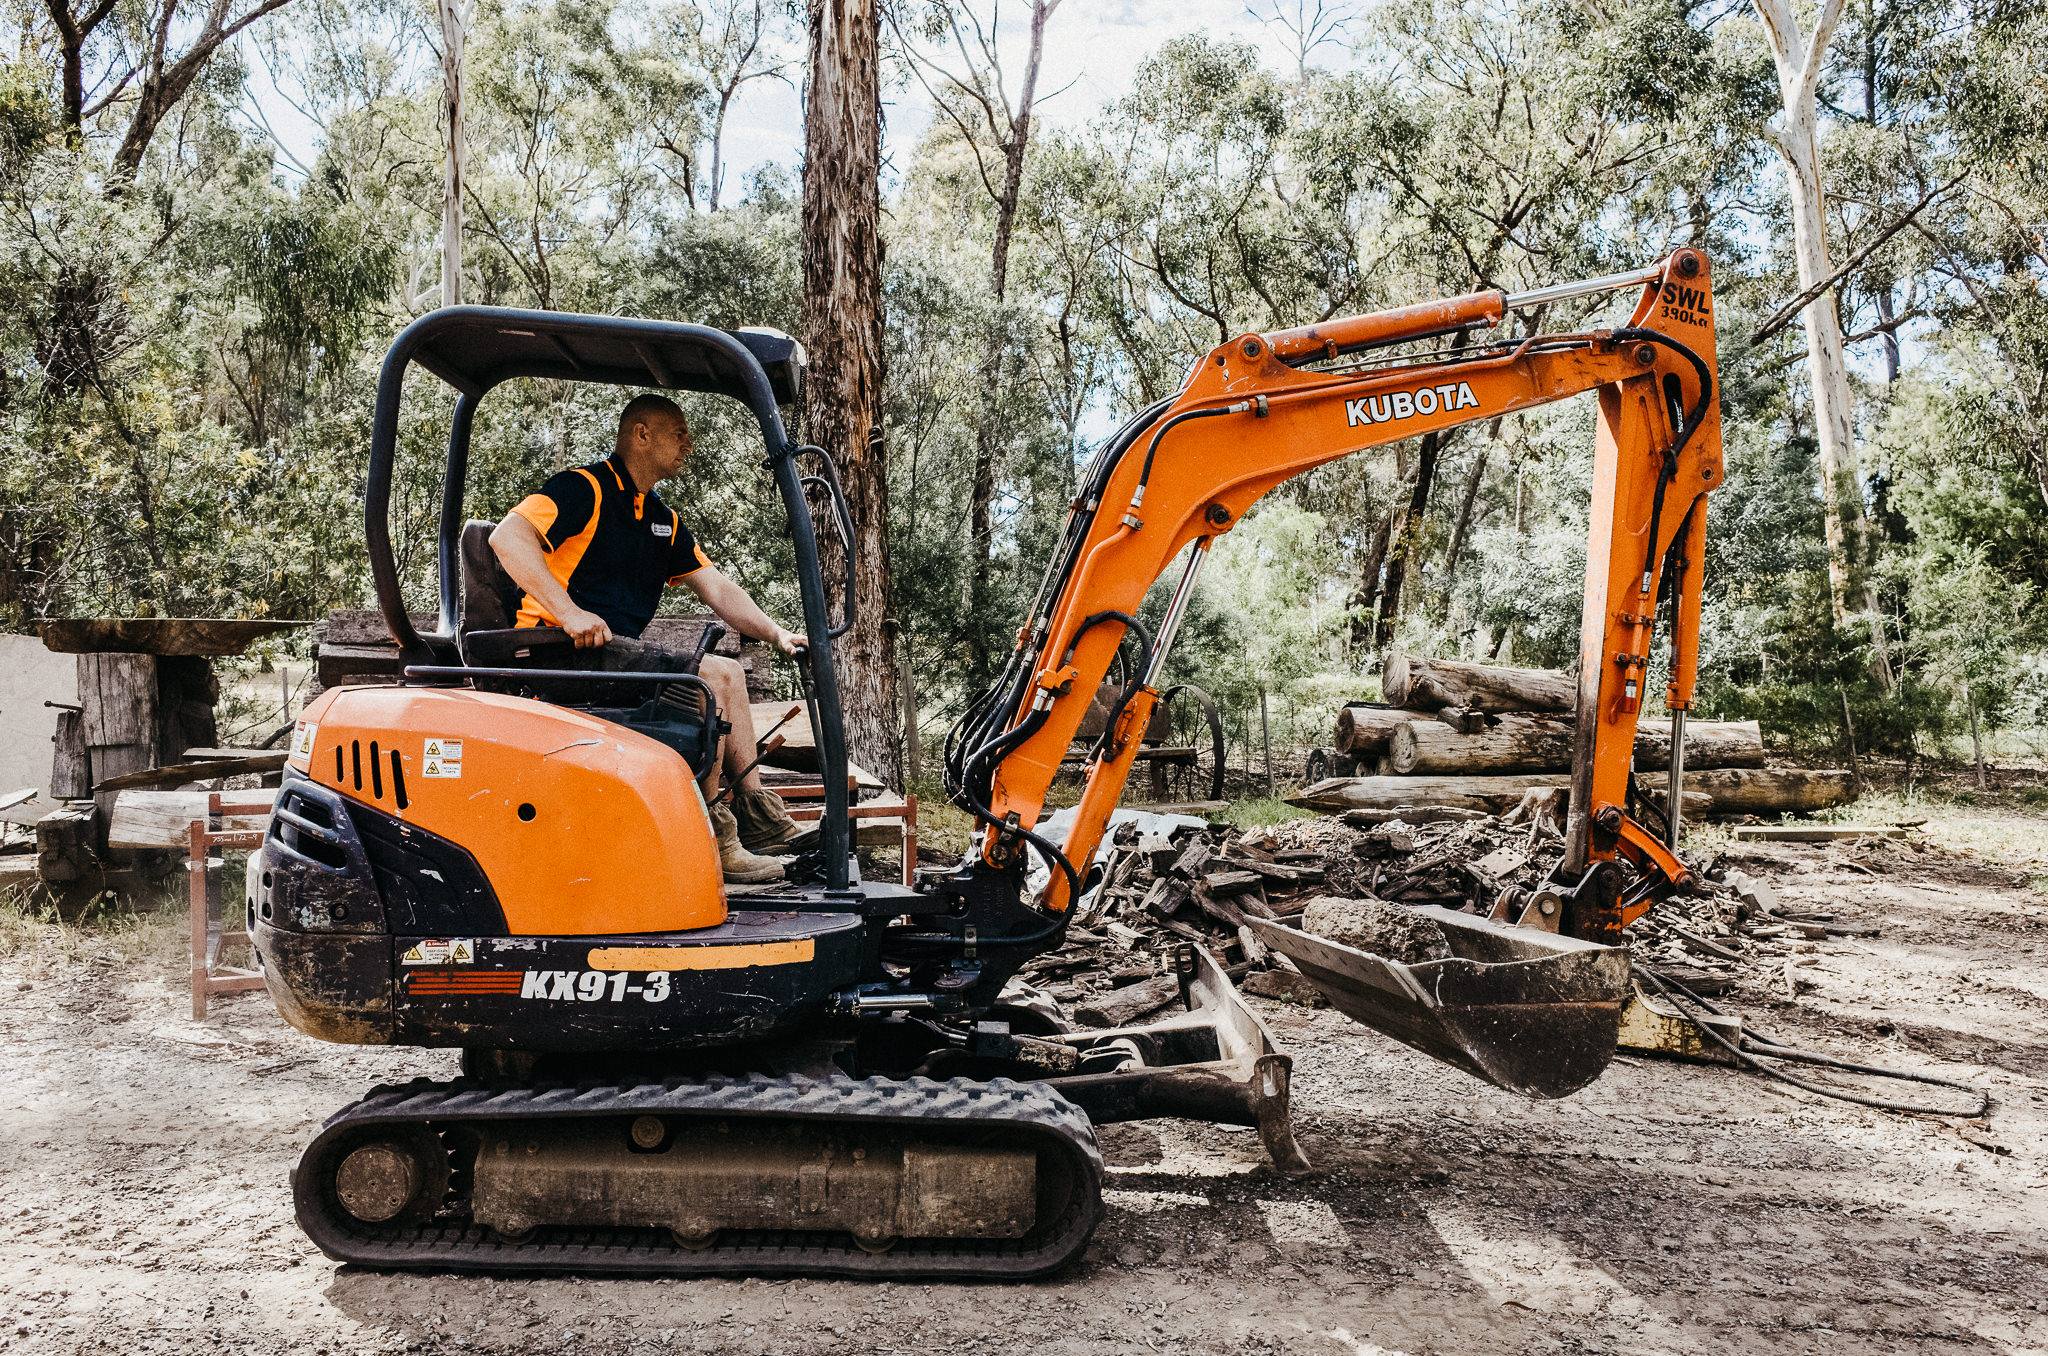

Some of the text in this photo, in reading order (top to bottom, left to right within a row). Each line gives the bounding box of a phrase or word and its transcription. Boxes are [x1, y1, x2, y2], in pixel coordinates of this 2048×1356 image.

[1663, 282, 1710, 314] SWL
[1345, 381, 1480, 427] KUBOTA
[520, 970, 671, 1003] KX91-3
